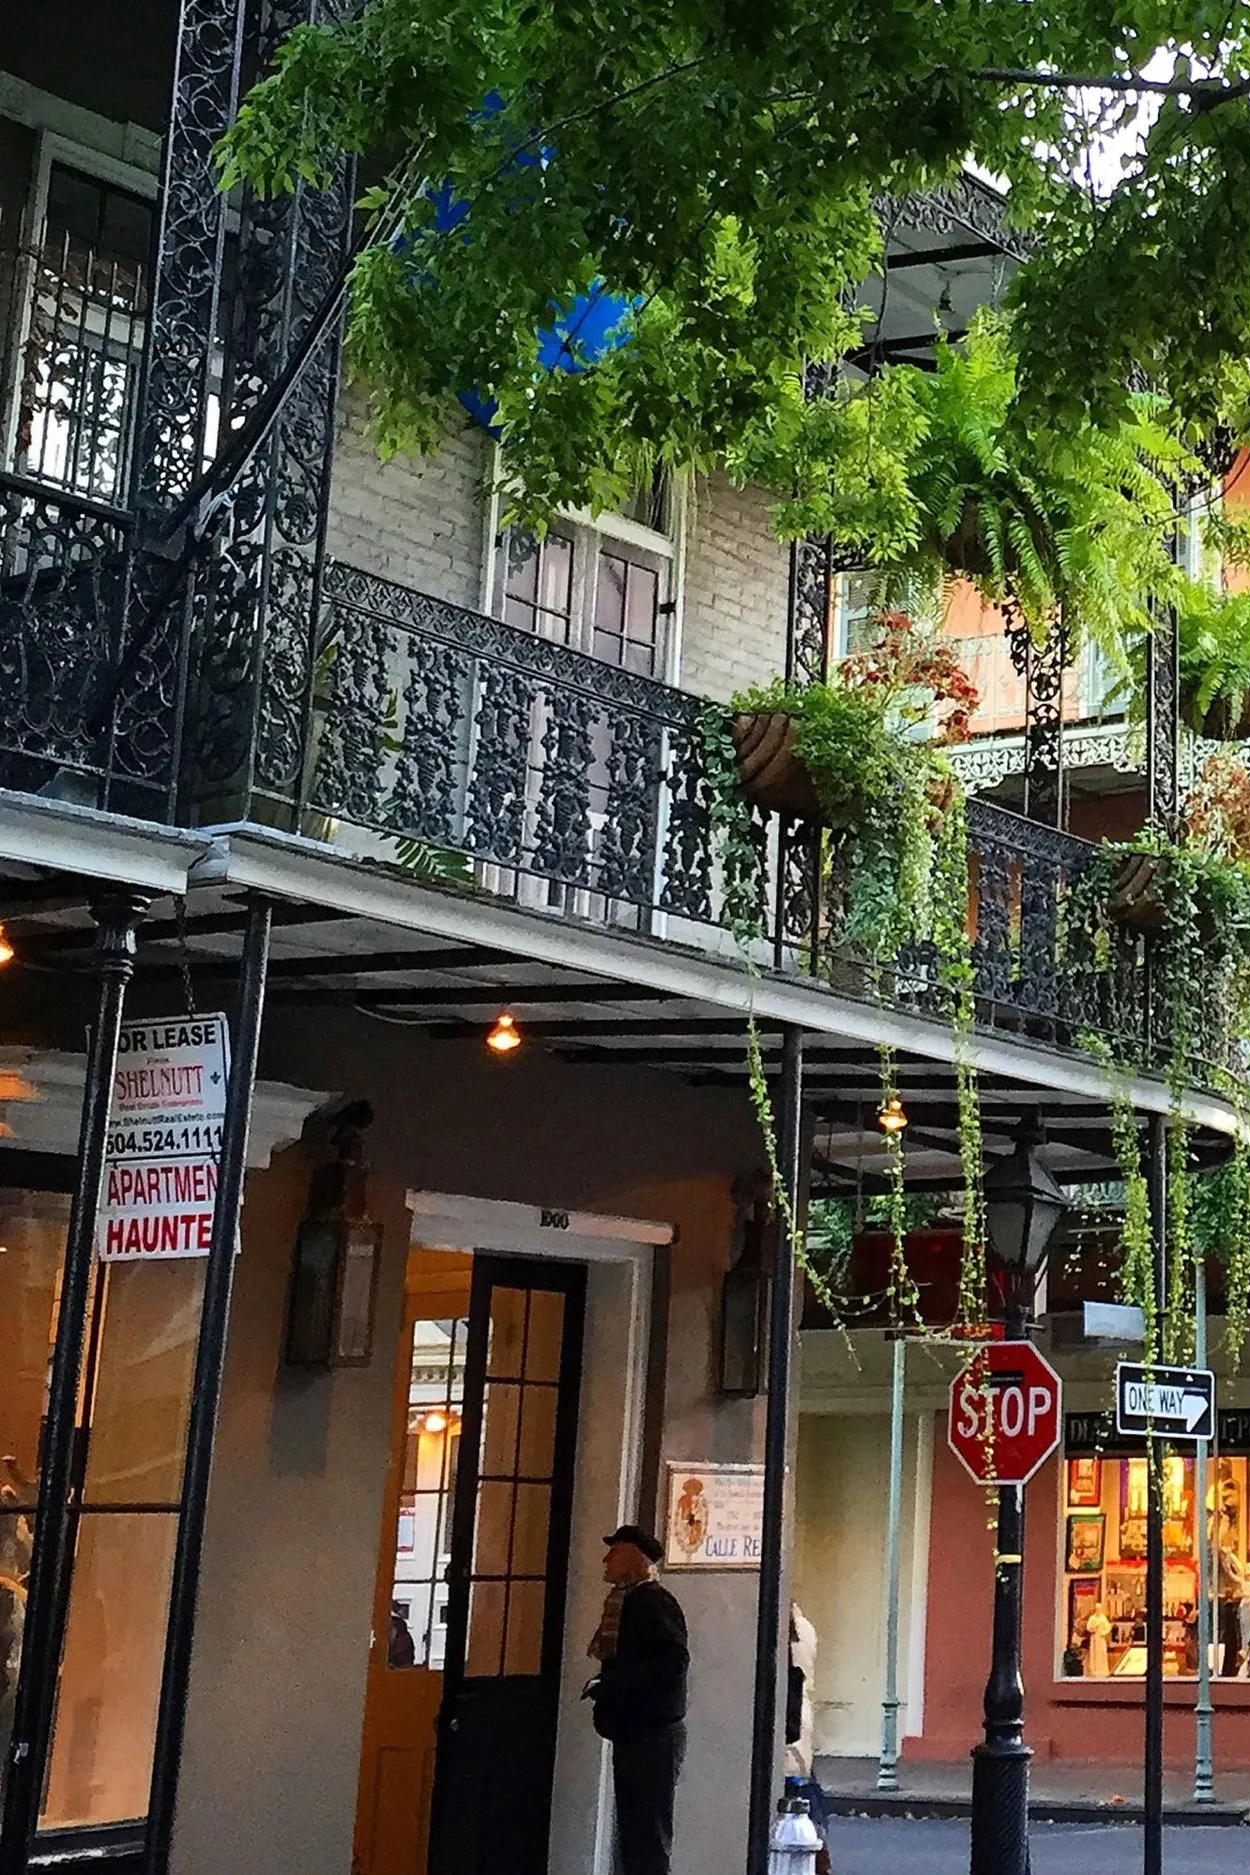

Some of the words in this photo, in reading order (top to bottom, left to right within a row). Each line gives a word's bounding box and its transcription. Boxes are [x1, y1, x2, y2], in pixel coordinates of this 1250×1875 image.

[117, 1031, 148, 1053] OR
[152, 1024, 216, 1049] LEASE
[115, 1065, 203, 1100] SHELNUTT
[106, 1164, 218, 1207] APARTMEN
[106, 1213, 213, 1255] HAUNTE
[540, 1210, 570, 1230] 1000
[957, 1385, 1052, 1438] STOP
[1128, 1385, 1155, 1414] ONE
[1158, 1389, 1185, 1415] WAY
[705, 1535, 737, 1557] CALLE
[743, 1534, 761, 1557] RE
